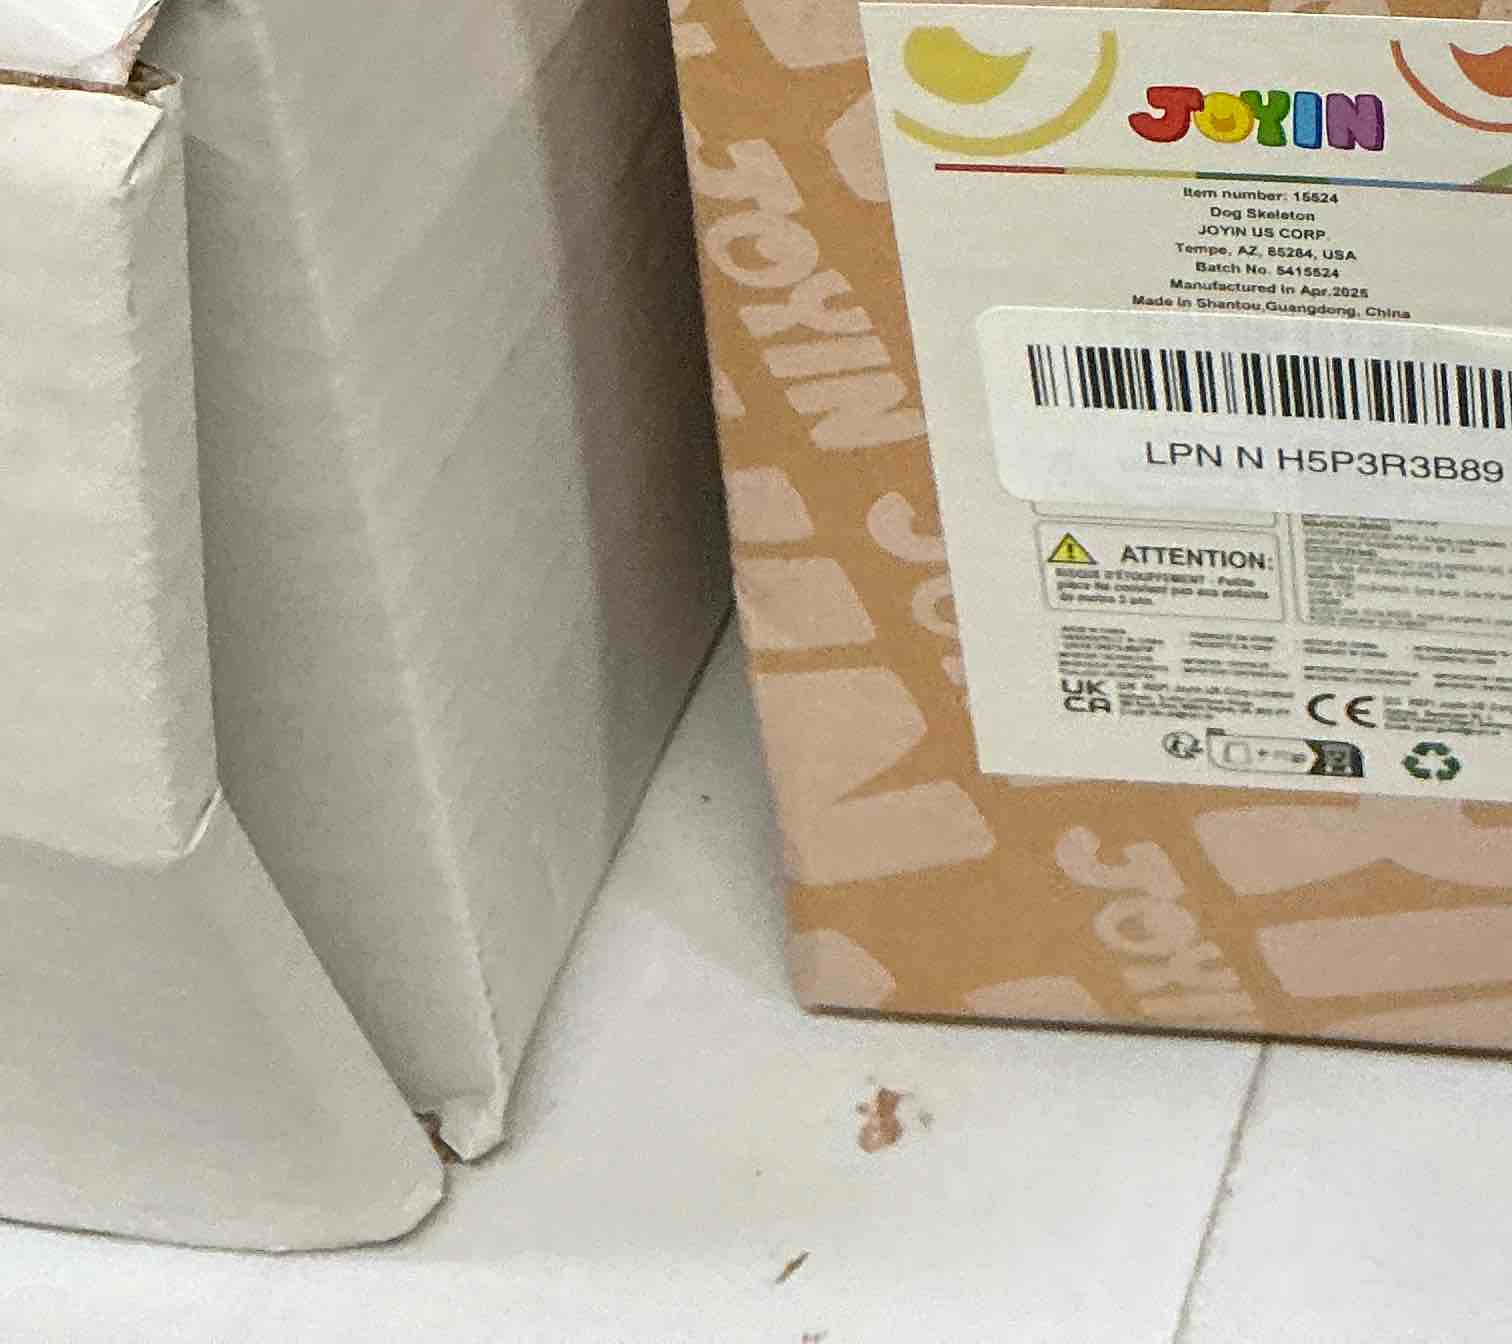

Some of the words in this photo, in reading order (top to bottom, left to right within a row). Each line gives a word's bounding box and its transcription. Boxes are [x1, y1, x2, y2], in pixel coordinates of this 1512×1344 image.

[1127, 85, 1386, 152] JOYIN
[1183, 186, 1218, 199] Item
[1222, 189, 1288, 202] number:
[1293, 191, 1340, 204] 15524
[1209, 206, 1242, 221] Dog
[1246, 207, 1316, 222] Skeleton
[1198, 225, 1247, 238] JOYIN
[1252, 226, 1275, 239] US
[1322, 248, 1358, 261] USA
[1195, 261, 1241, 275] Batch
[1170, 278, 1277, 295] Manufactured
[1132, 294, 1174, 308] Made
[1365, 305, 1412, 320] China
[1145, 441, 1223, 468] LPN
[1236, 445, 1264, 470] N
[1277, 448, 1505, 483] H5P3R3B89
[1120, 543, 1275, 571] ATTENTION:
[1062, 679, 1107, 696] UK
[1064, 696, 1111, 714] CA
[1306, 693, 1378, 729] CE
